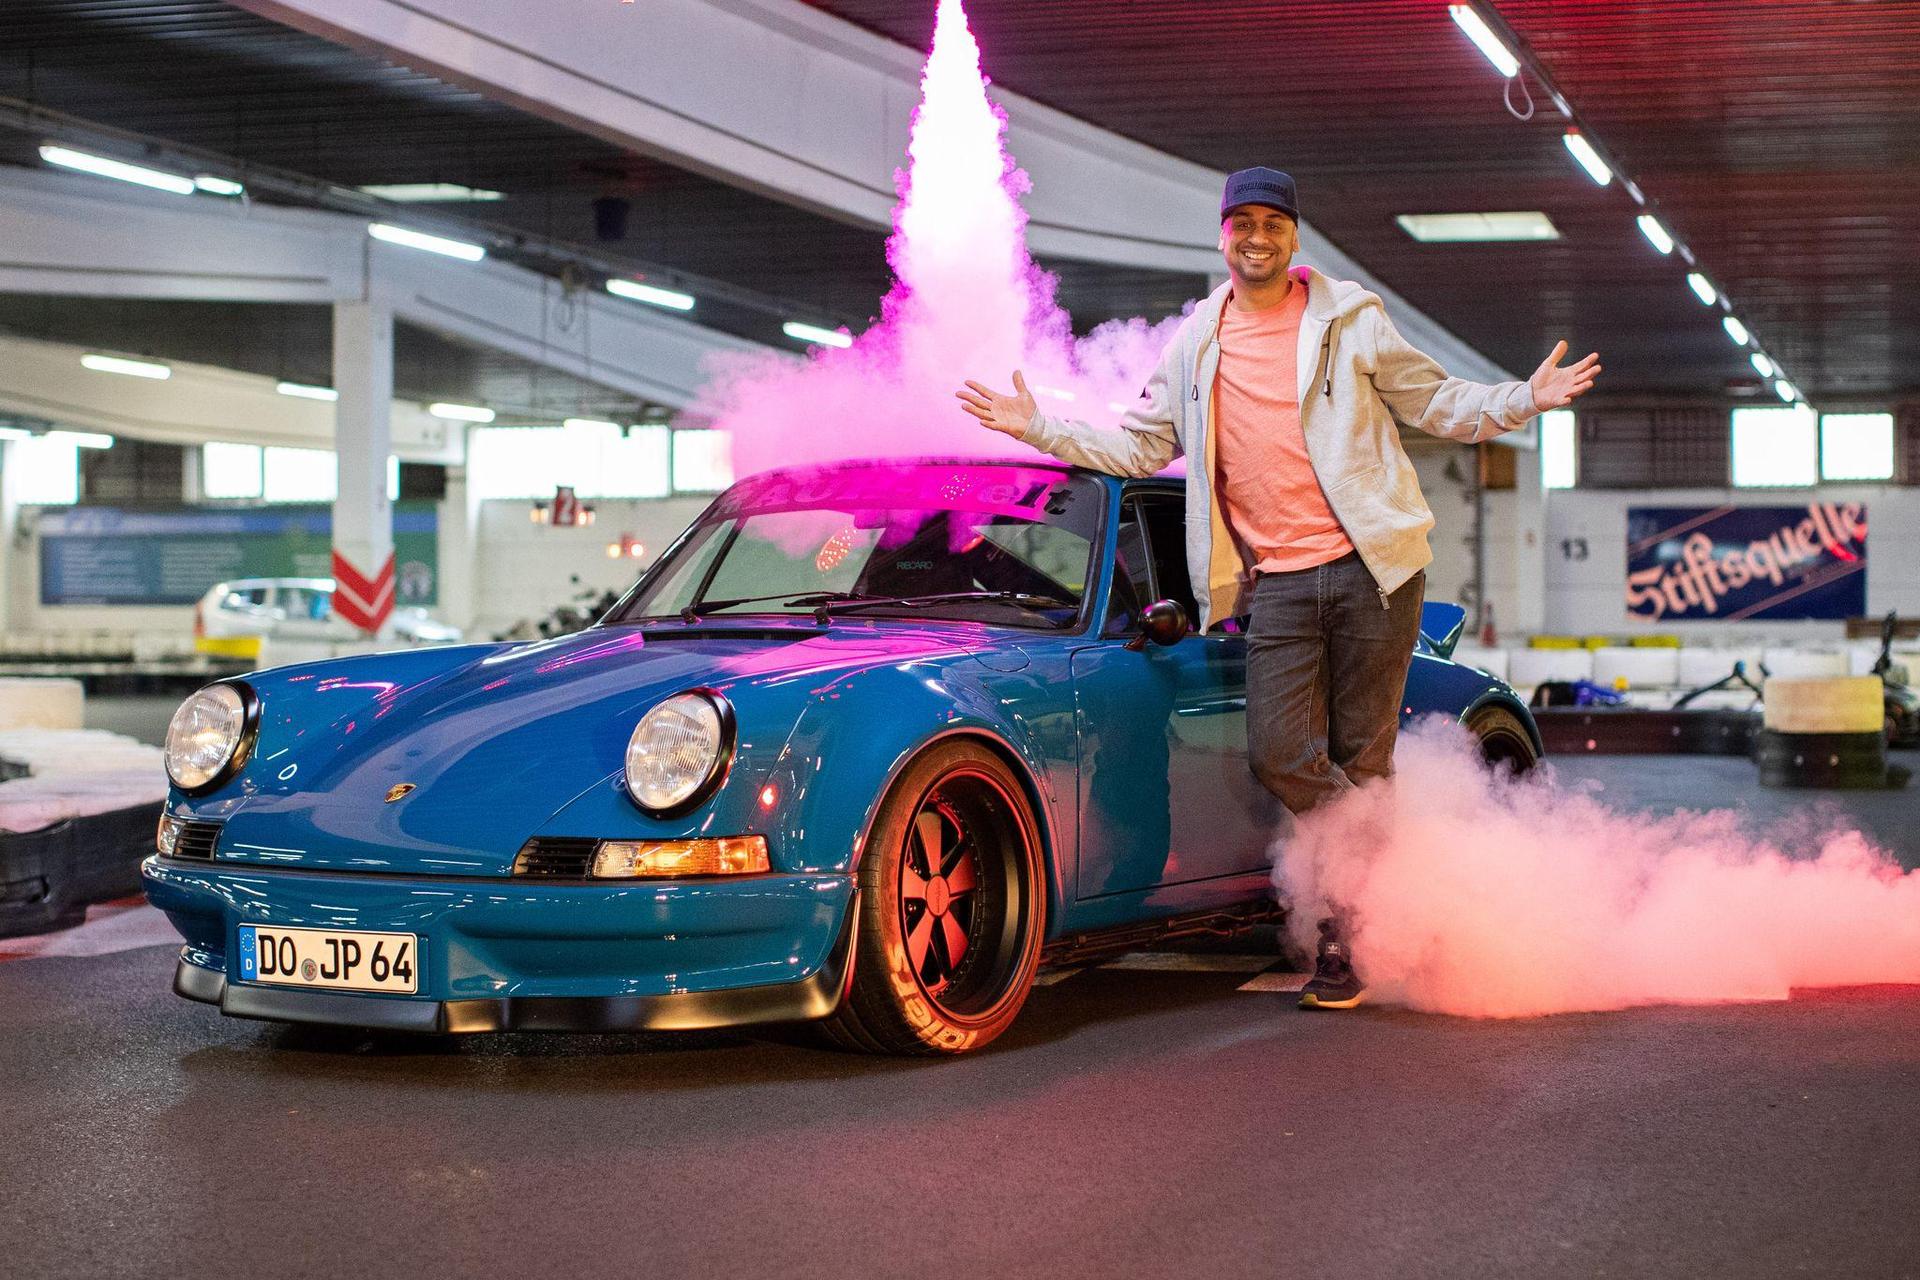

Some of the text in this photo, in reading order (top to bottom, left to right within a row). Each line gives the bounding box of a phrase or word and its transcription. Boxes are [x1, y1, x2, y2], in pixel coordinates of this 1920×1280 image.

[1561, 538, 1588, 561] 13
[245, 958, 253, 970] D
[258, 934, 412, 983] DO JP 64
